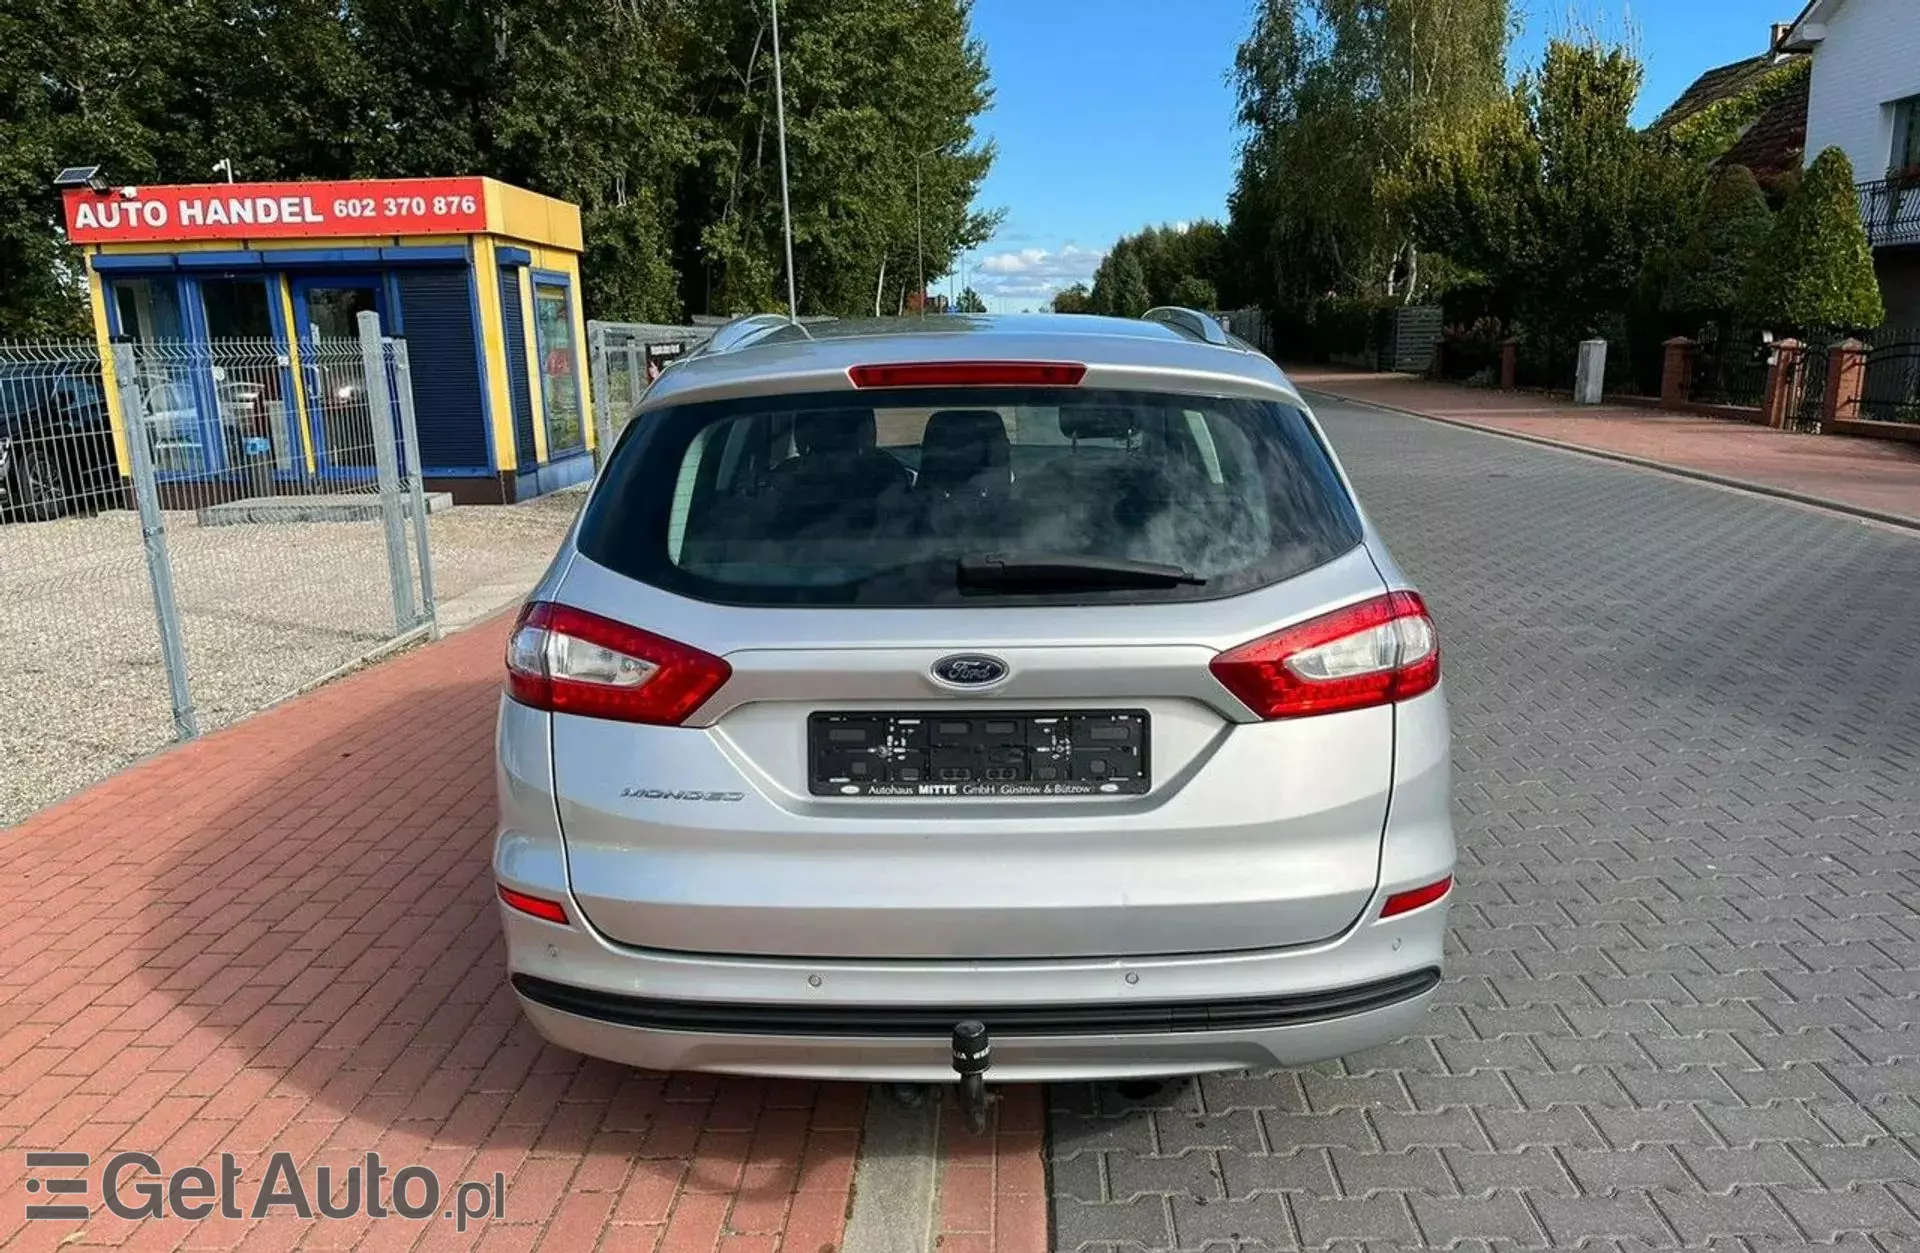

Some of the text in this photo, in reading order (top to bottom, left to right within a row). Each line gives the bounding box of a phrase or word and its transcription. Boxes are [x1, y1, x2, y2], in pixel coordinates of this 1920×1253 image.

[75, 195, 477, 229] AUTO HANDEL 602 370 876
[948, 661, 990, 679] Ford
[620, 787, 745, 802] MONDEO
[868, 785, 914, 795] Autohaus
[918, 784, 957, 795] MITTE
[963, 784, 996, 795] GmbH
[1043, 784, 1052, 794] &
